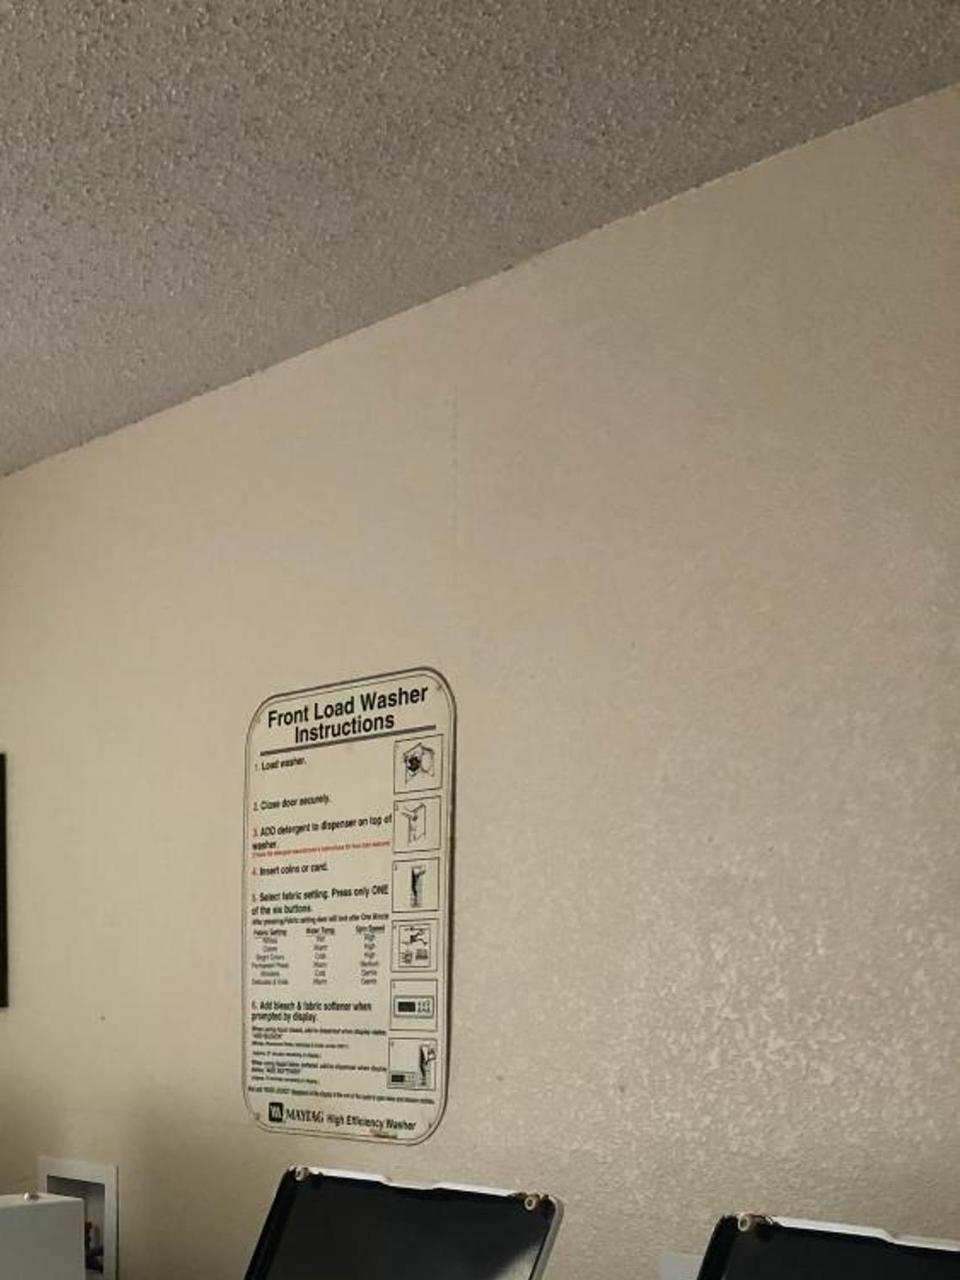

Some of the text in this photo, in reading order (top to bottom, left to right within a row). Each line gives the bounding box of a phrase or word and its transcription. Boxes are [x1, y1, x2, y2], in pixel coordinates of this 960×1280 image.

[268, 686, 429, 728] Front Load Washer
[295, 714, 395, 743] Instructions
[261, 760, 279, 771] Load
[260, 800, 280, 810] Close
[282, 798, 298, 808] door
[260, 825, 276, 836] ADD
[277, 823, 310, 836] detergent
[321, 819, 356, 831] dispenser
[358, 818, 368, 827] on
[369, 816, 382, 826] top
[260, 865, 279, 876] Insert
[280, 864, 300, 874] coins
[301, 864, 310, 873] or
[260, 892, 281, 902] Select
[282, 890, 302, 900] fabric
[332, 887, 352, 898] Press
[354, 886, 370, 899] only
[371, 884, 389, 895] ONE
[260, 906, 271, 915] the
[260, 1000, 272, 1010] Add
[273, 1000, 295, 1011] bleach
[303, 1000, 322, 1011] fabric
[324, 1001, 351, 1011] softener
[353, 1000, 372, 1011] when
[251, 1012, 282, 1022] prompted
[283, 1013, 292, 1024] by
[285, 1107, 416, 1131] MAYTAG High Efficiency Washer
